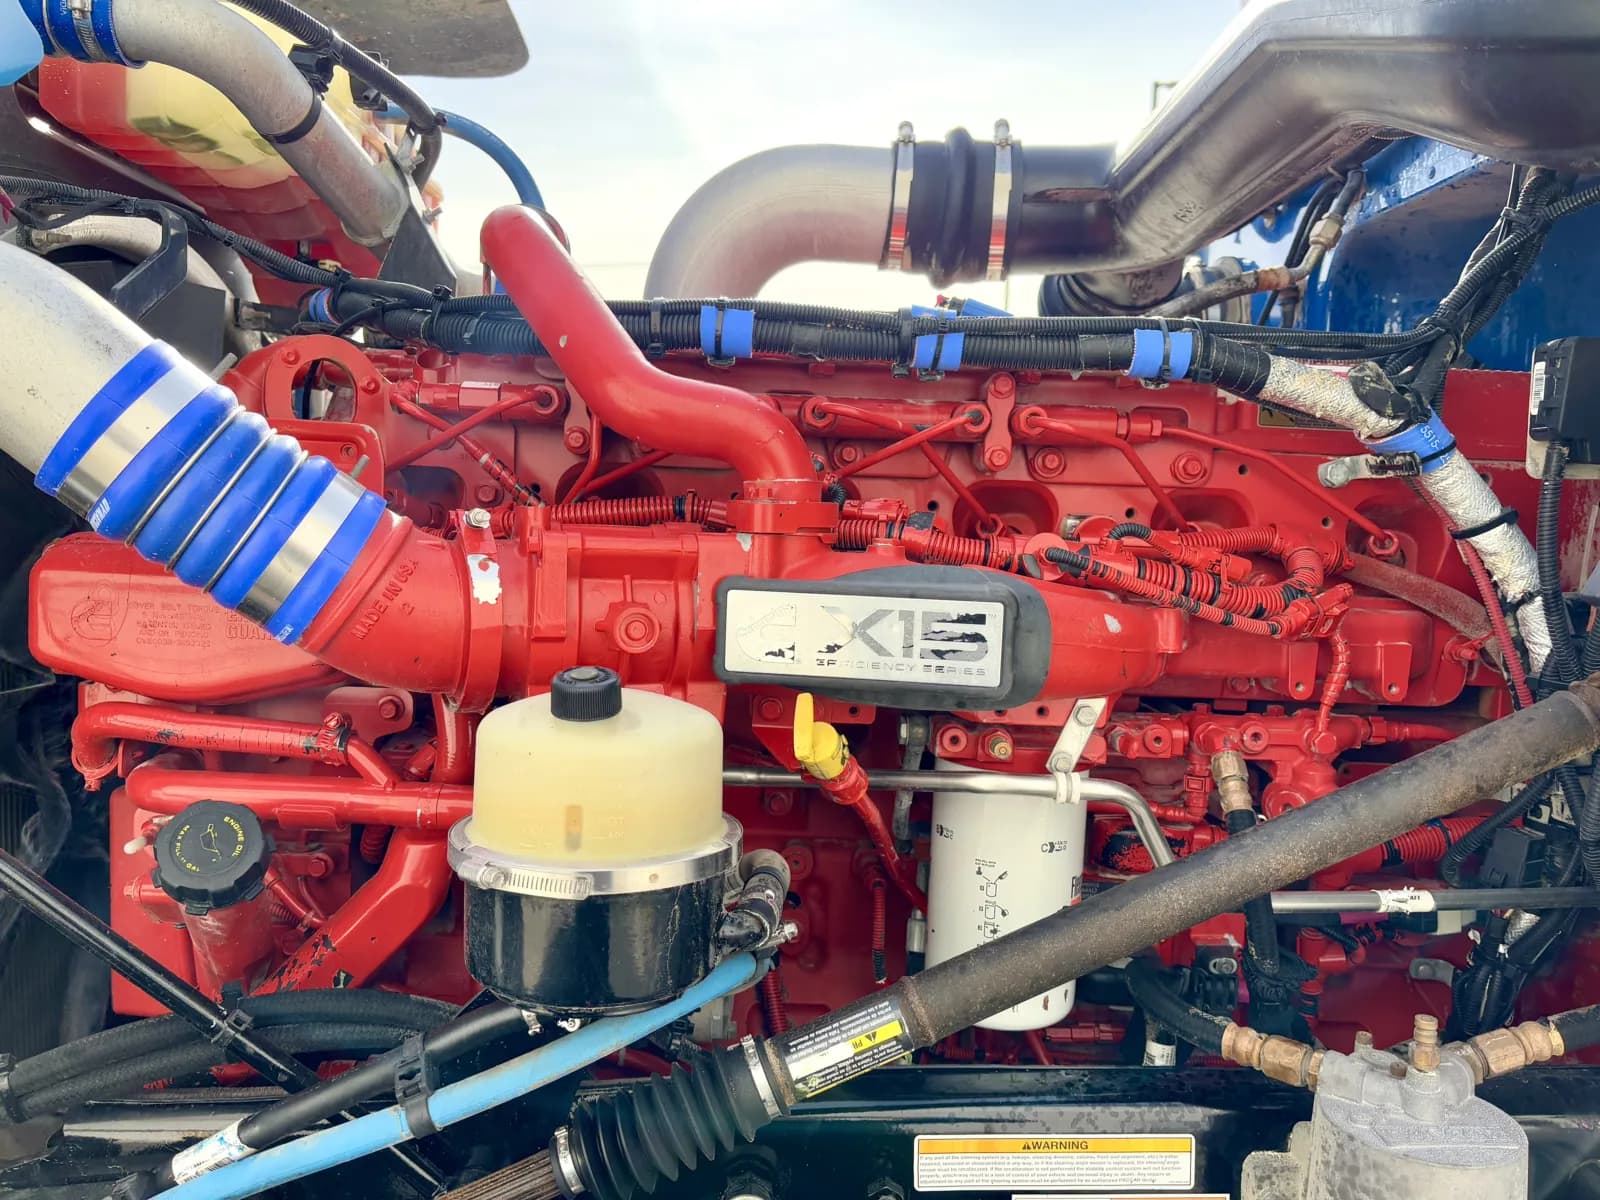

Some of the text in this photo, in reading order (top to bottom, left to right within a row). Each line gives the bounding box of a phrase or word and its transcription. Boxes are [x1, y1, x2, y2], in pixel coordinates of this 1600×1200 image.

[351, 599, 389, 640] MADE
[382, 581, 402, 602] IN
[815, 604, 989, 663] X15
[176, 824, 191, 841] MAX
[223, 816, 245, 858] ENGINE OIL
[1032, 1140, 1089, 1150] WARNING
